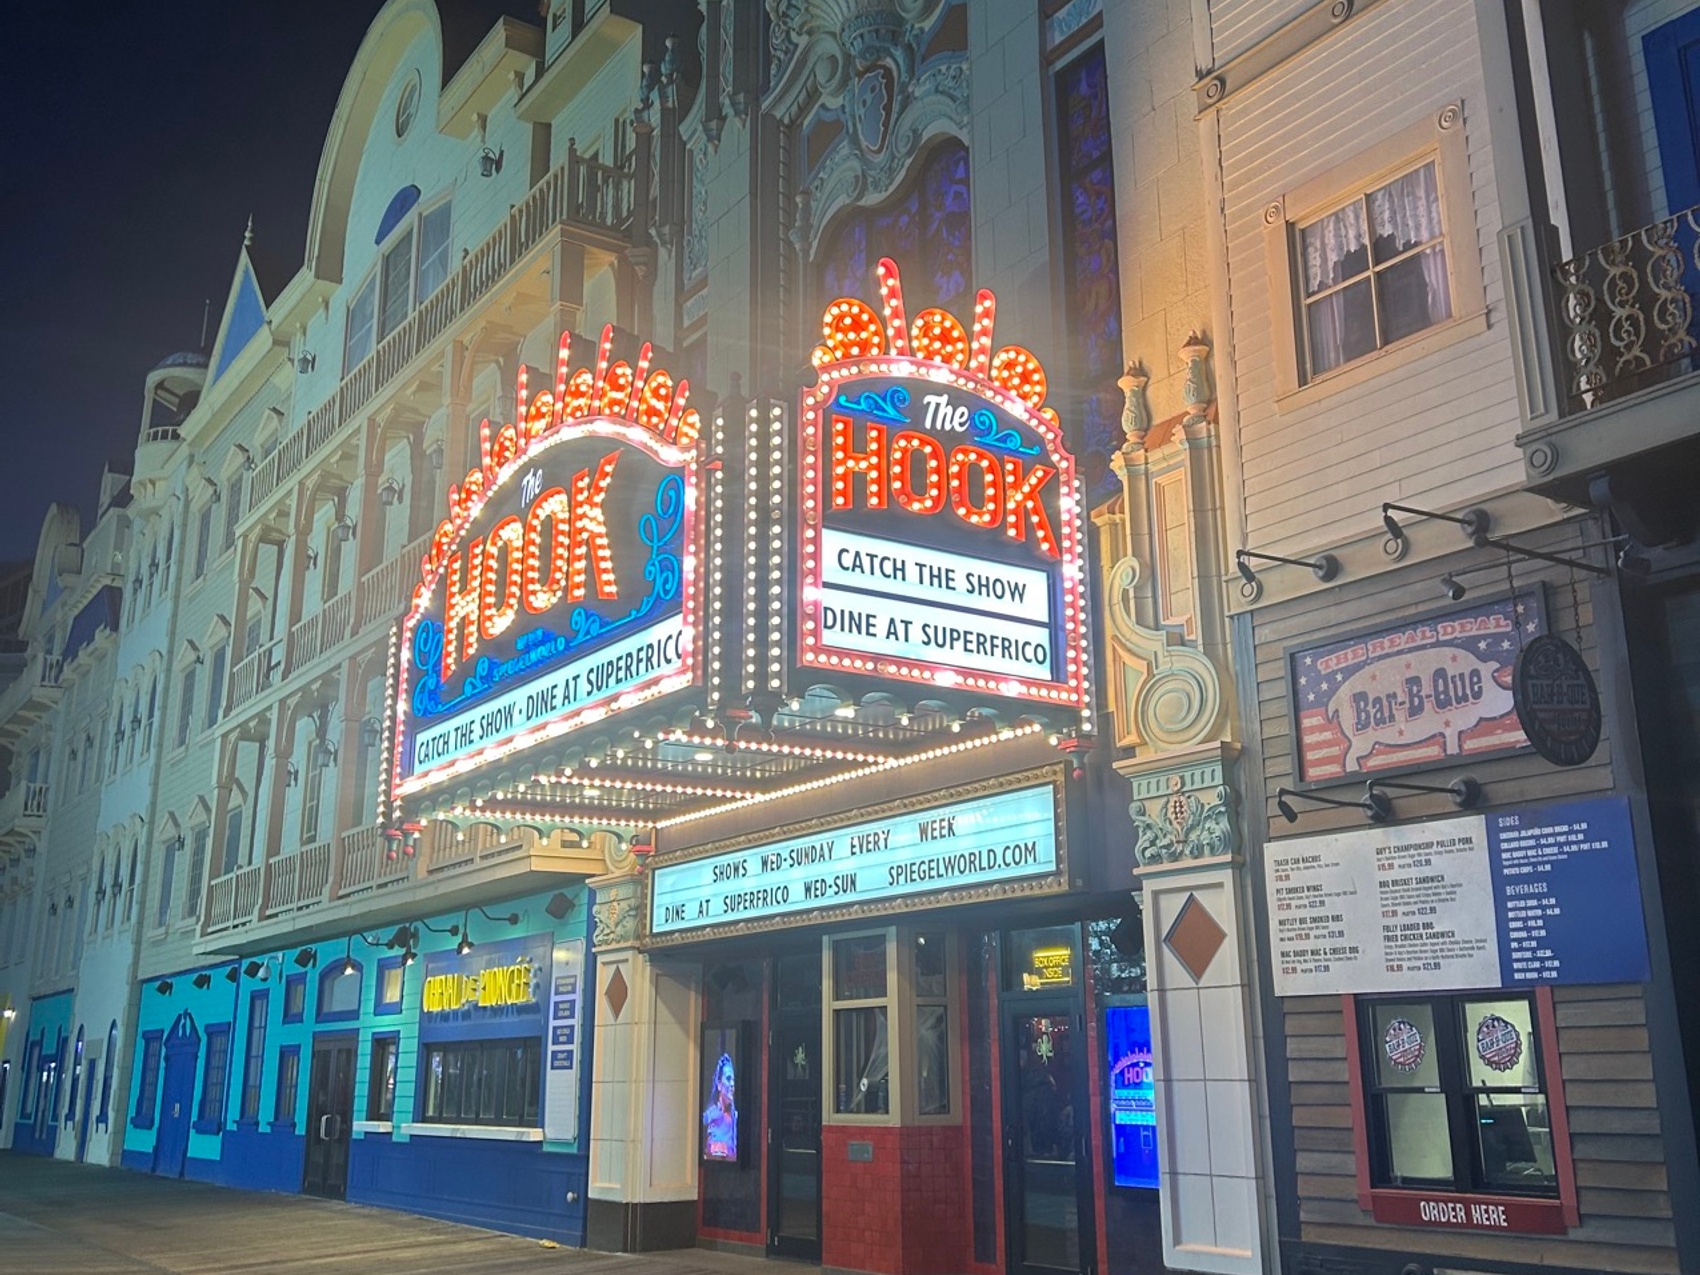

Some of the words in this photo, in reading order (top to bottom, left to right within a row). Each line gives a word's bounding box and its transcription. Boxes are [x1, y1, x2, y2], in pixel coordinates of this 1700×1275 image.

[923, 394, 969, 433] The
[521, 467, 543, 508] The
[831, 414, 1061, 561] HOOK
[442, 449, 623, 683] HOOK
[837, 548, 906, 582] CATCH
[915, 562, 956, 591] THE
[966, 573, 1027, 604] SHOW
[823, 606, 877, 637] DINE
[886, 617, 913, 643] AT
[921, 623, 1047, 665] SUPERFRICO
[1318, 646, 1367, 673] THE
[1368, 628, 1435, 656] REAL
[1437, 615, 1512, 639] DEAL
[1353, 666, 1483, 733] Bar-B-Que
[418, 731, 450, 764] CATCH
[454, 719, 475, 750] THE
[479, 702, 516, 740] SHOW
[526, 685, 558, 722] DINE
[562, 675, 580, 707] AT
[1499, 816, 1520, 827] SIDES
[713, 859, 748, 883] SHOWS
[761, 841, 835, 872] WED-SUNDAY
[850, 829, 890, 855] EVERY
[919, 816, 956, 842] WEEK
[1376, 846, 1392, 855] GUY'S
[1393, 841, 1434, 853] CHAMPIONSHIP
[1436, 839, 1456, 848] PULLED
[1458, 836, 1473, 845] PORK
[1274, 859, 1289, 867] TRASH
[1302, 855, 1321, 864] NACHOS
[665, 904, 685, 923] DINE
[698, 899, 710, 918] AT
[723, 886, 789, 913] SUPERFRICO
[804, 873, 857, 899] WED-SUN
[889, 841, 1037, 886] SPIEGELWORLD.COM
[1306, 884, 1323, 892] WINGS
[1379, 880, 1390, 888] BBQ
[1391, 877, 1413, 887] BRISKET
[1415, 875, 1445, 885] SANDWICH
[1506, 883, 1548, 895] BEVERAGES
[1310, 915, 1329, 924] SMOKED
[1331, 914, 1343, 922] RIBS
[1399, 923, 1420, 932] LOADED
[1384, 935, 1398, 943] FRIED
[1400, 933, 1424, 942] CHICKEN
[1425, 930, 1455, 940] SANDWICH
[1049, 955, 1069, 966] OFFICE
[1280, 950, 1291, 958] MAC
[1293, 949, 1308, 957] DADDY
[1310, 948, 1321, 956] MAC
[1329, 947, 1347, 955] CHEESE
[1419, 1201, 1466, 1224] ORDER
[1471, 1204, 1508, 1227] HERE
